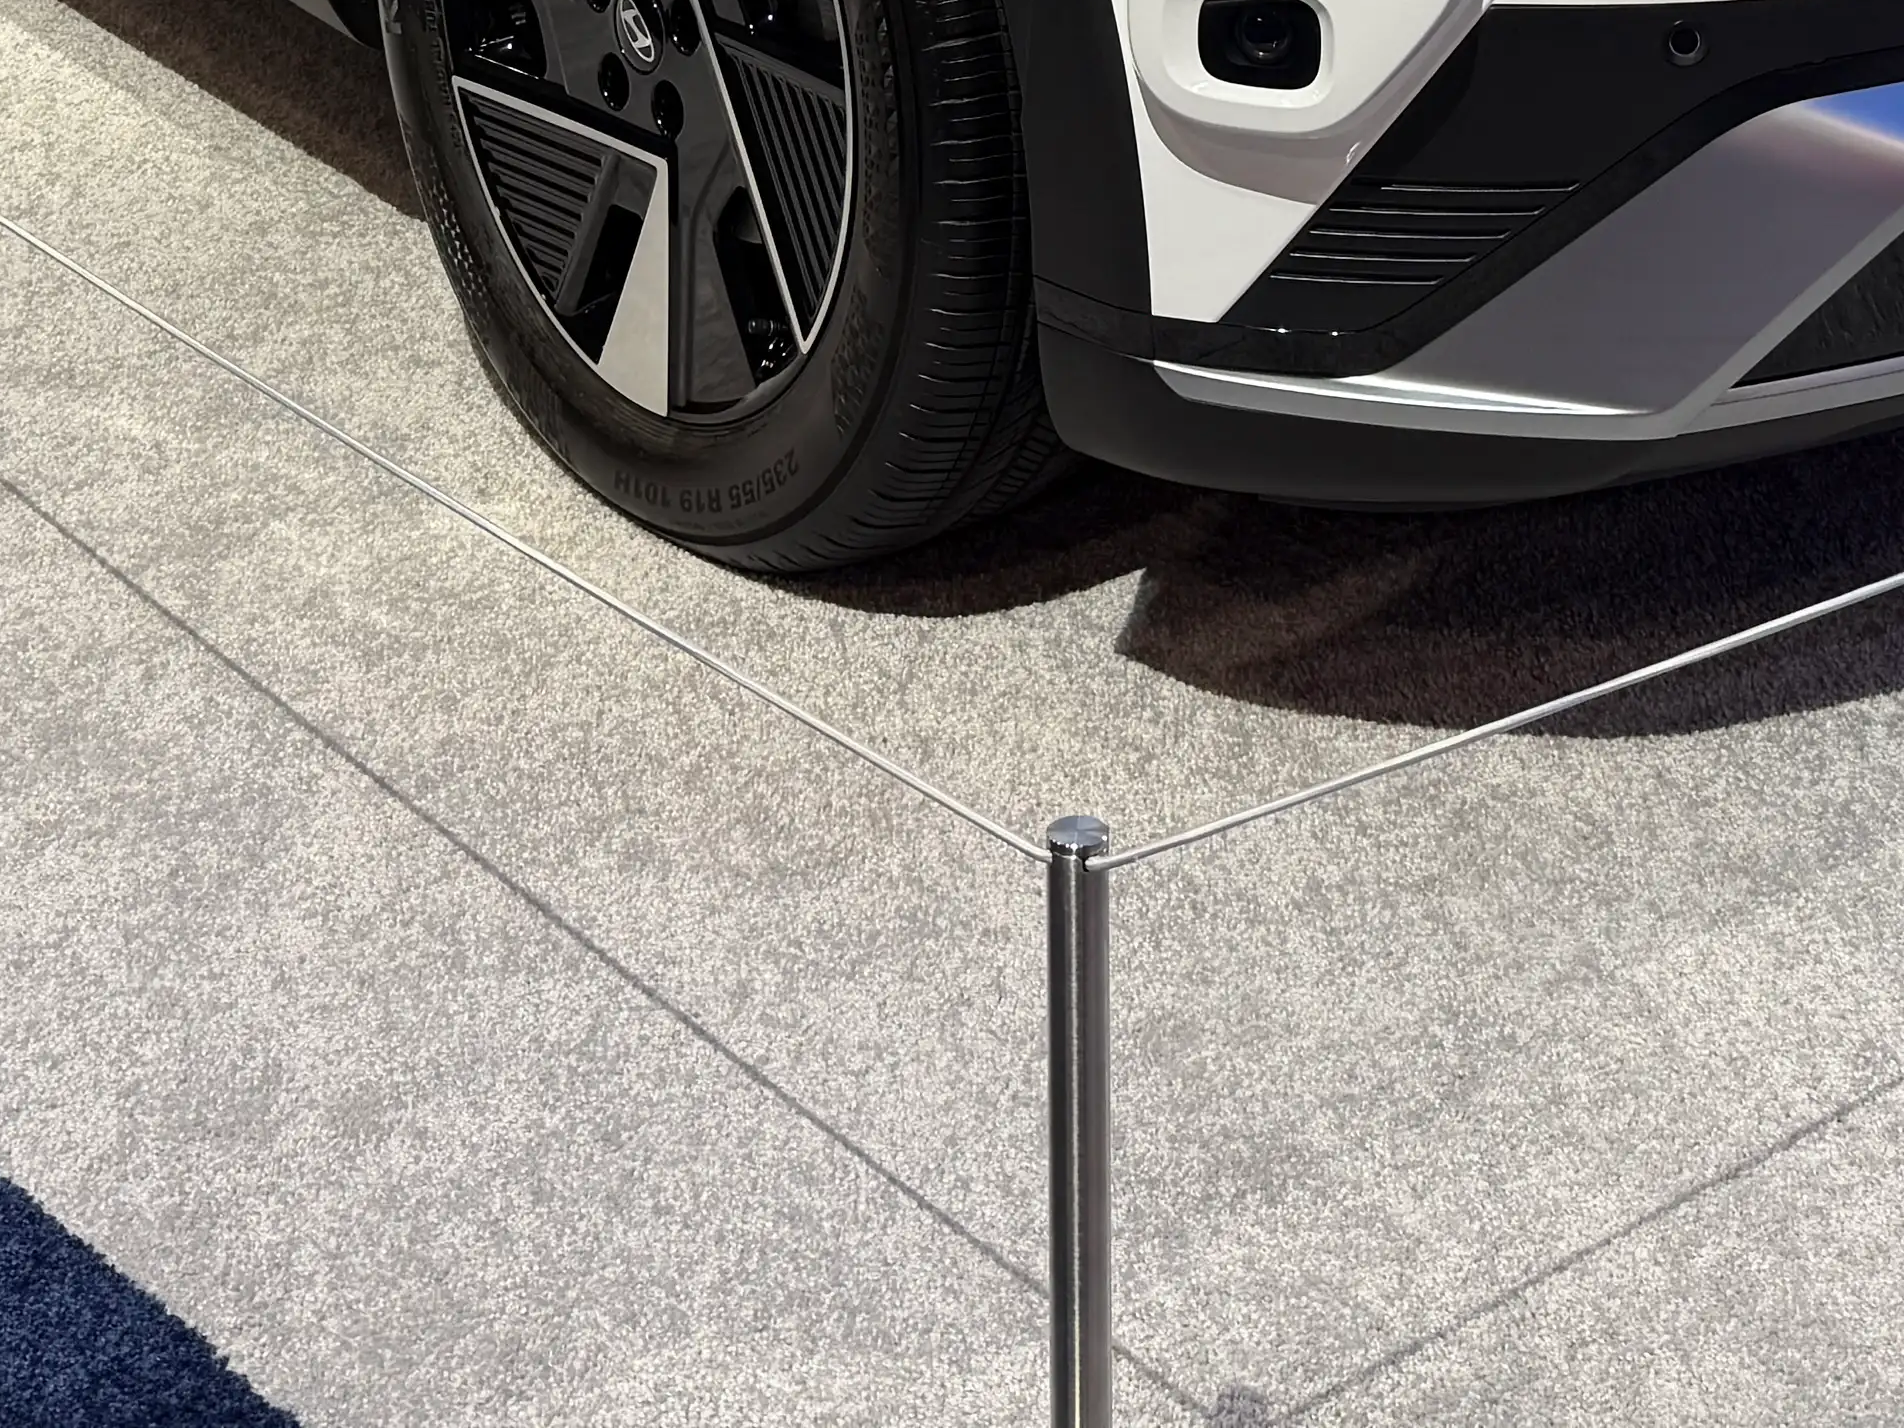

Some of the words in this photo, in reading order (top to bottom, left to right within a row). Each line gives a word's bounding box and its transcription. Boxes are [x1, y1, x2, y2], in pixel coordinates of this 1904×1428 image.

[613, 469, 672, 508] 101H
[729, 449, 800, 511] 235/55
[680, 487, 723, 514] R19
